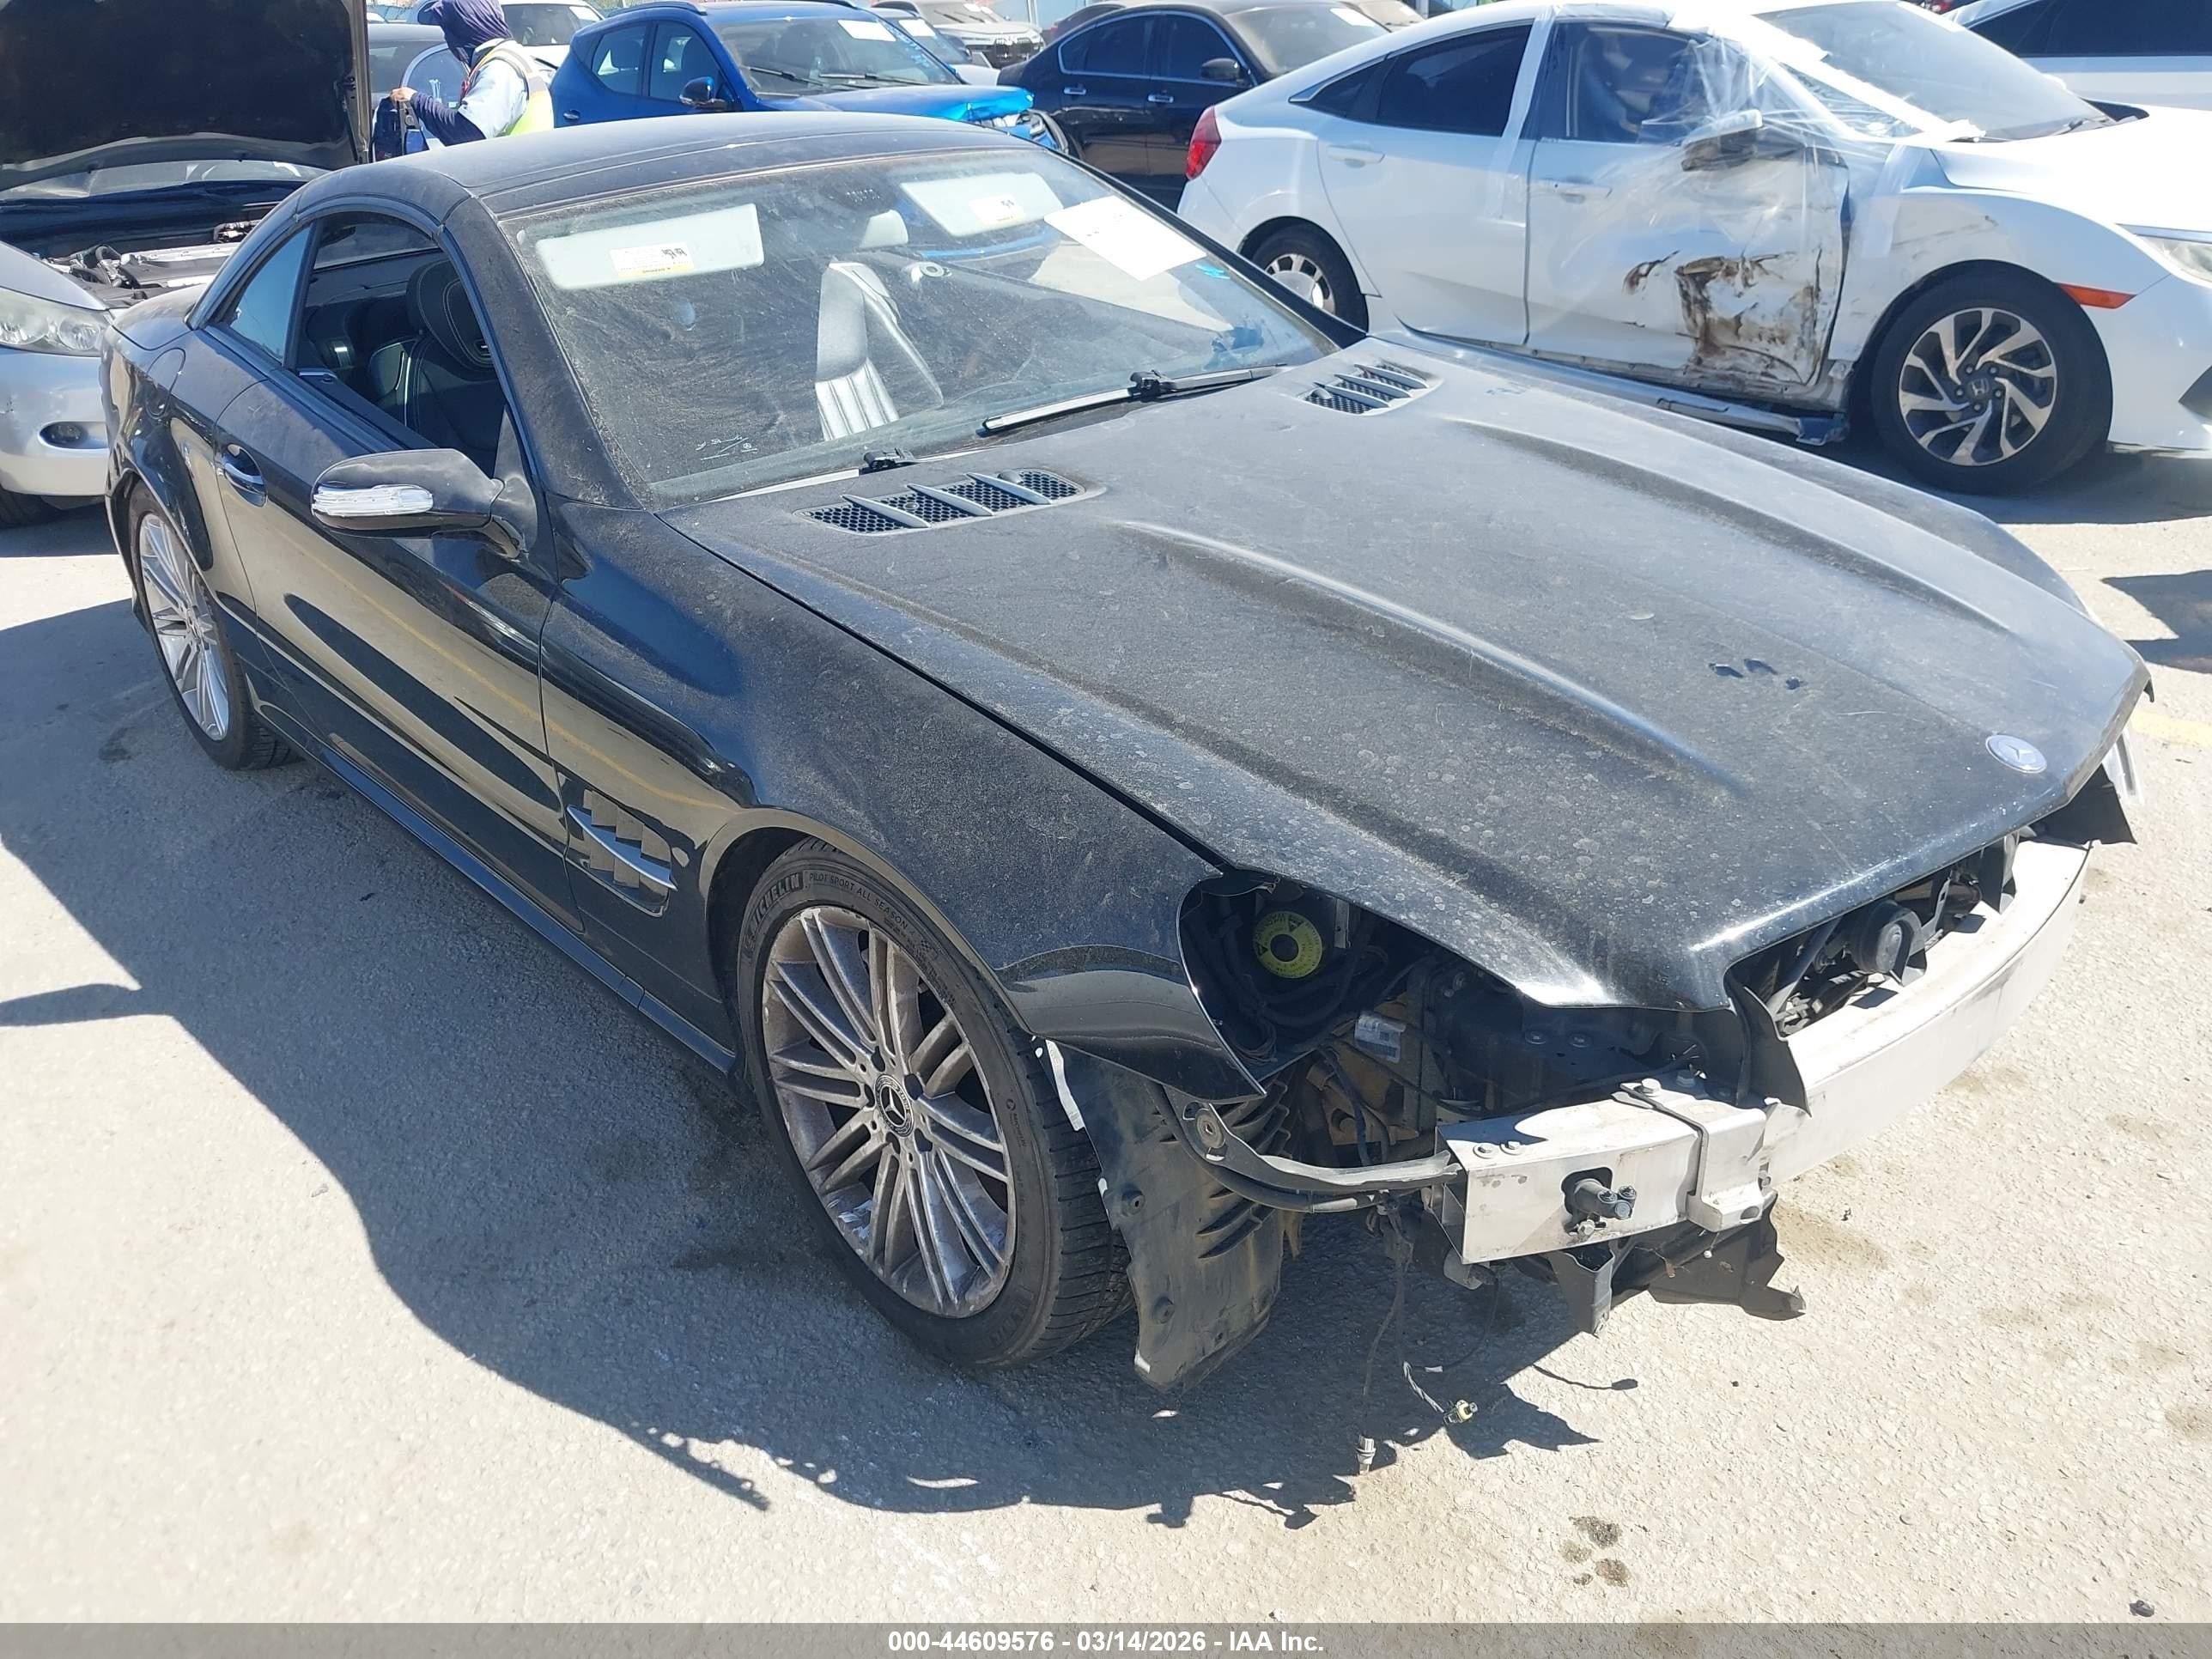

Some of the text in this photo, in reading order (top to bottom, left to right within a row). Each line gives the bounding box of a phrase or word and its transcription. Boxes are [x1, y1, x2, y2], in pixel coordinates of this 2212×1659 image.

[810, 872, 828, 882] PILOT
[830, 875, 855, 890] SPORT
[859, 888, 872, 902] ALL
[874, 899, 908, 930] SEASON
